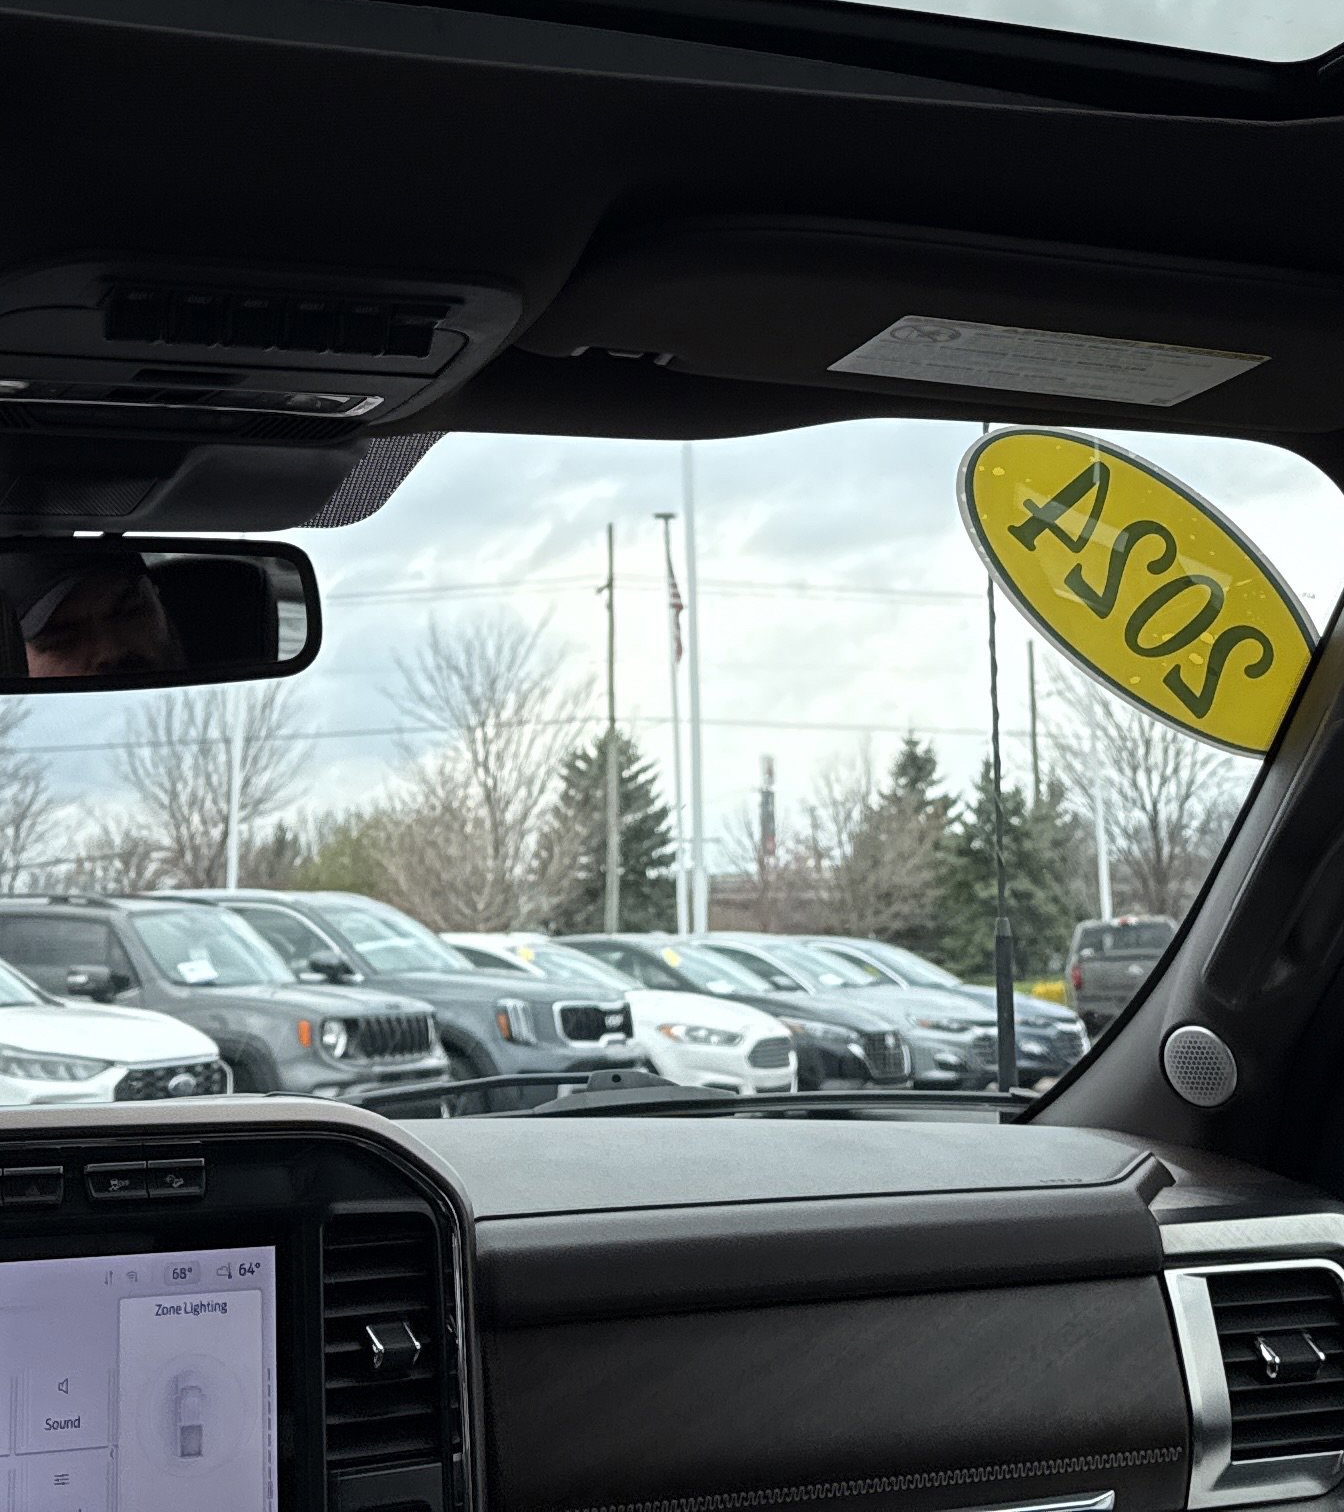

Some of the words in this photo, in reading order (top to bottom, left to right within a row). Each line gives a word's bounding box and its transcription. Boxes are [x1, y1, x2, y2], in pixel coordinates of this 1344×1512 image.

[155, 1303, 182, 1317] Zone
[183, 1300, 228, 1317] Lighting
[44, 1415, 81, 1431] Sound
